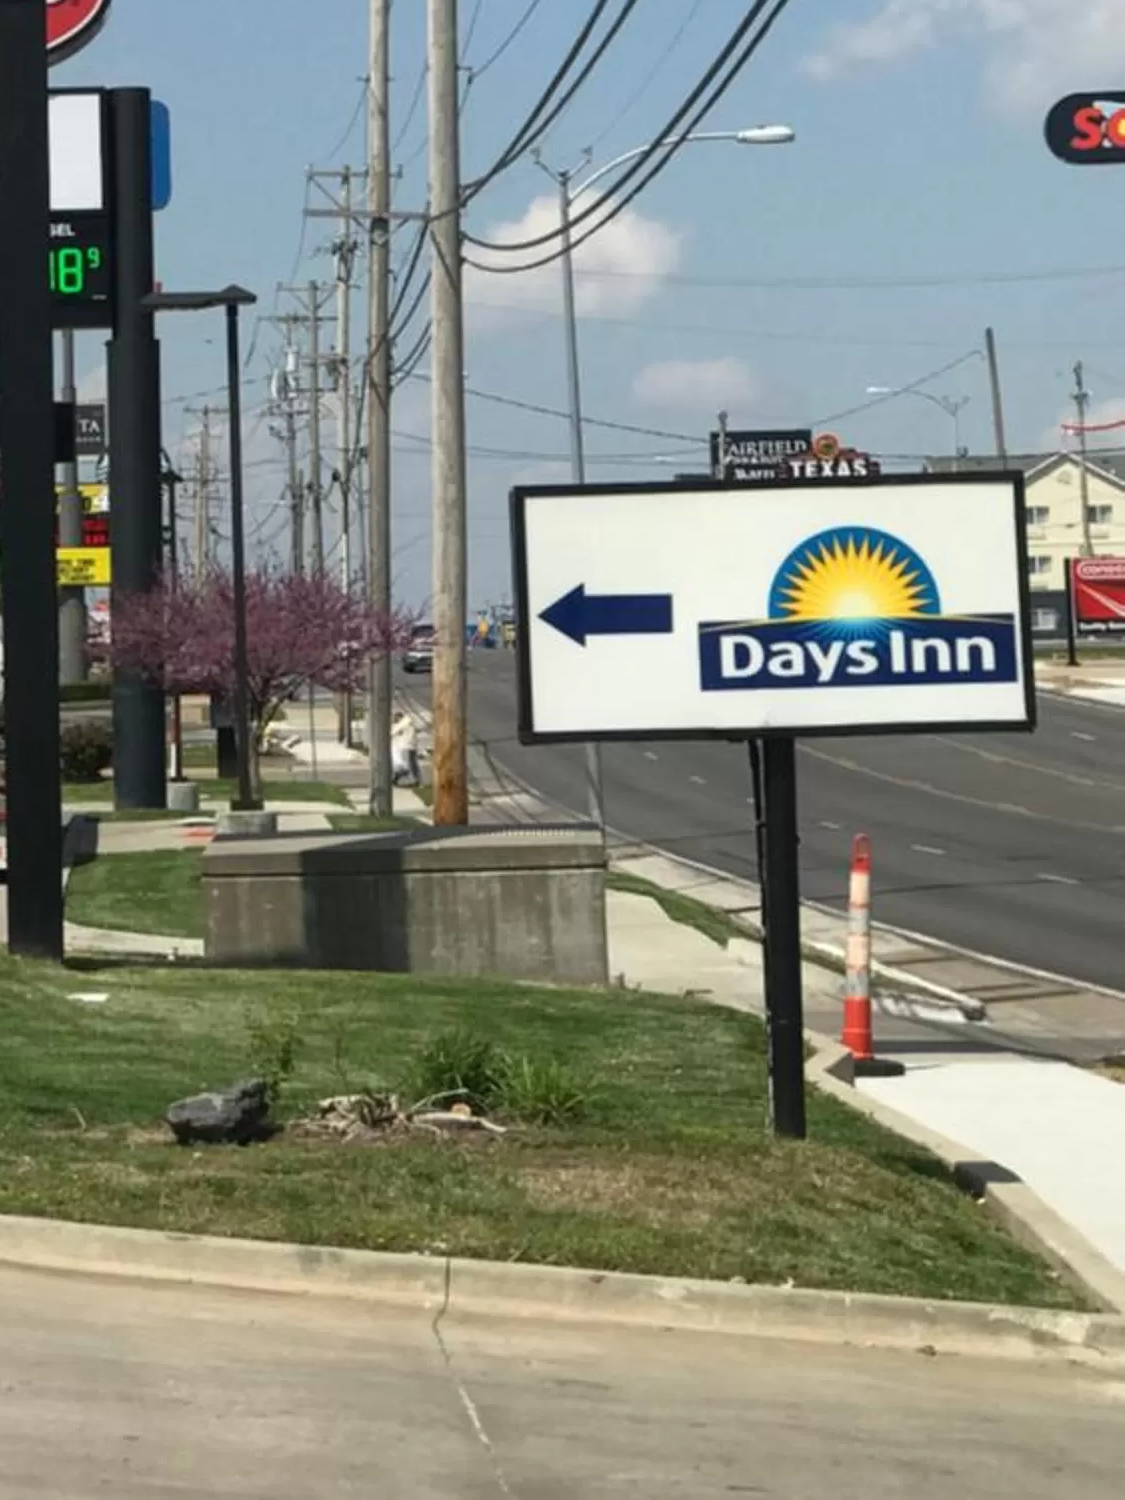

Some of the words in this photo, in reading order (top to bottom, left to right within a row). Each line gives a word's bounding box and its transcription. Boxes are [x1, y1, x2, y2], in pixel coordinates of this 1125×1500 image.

[723, 438, 807, 456] AIRFIELD
[789, 459, 869, 478] TEXAS
[719, 634, 879, 683] Days
[888, 630, 996, 673] Inn
